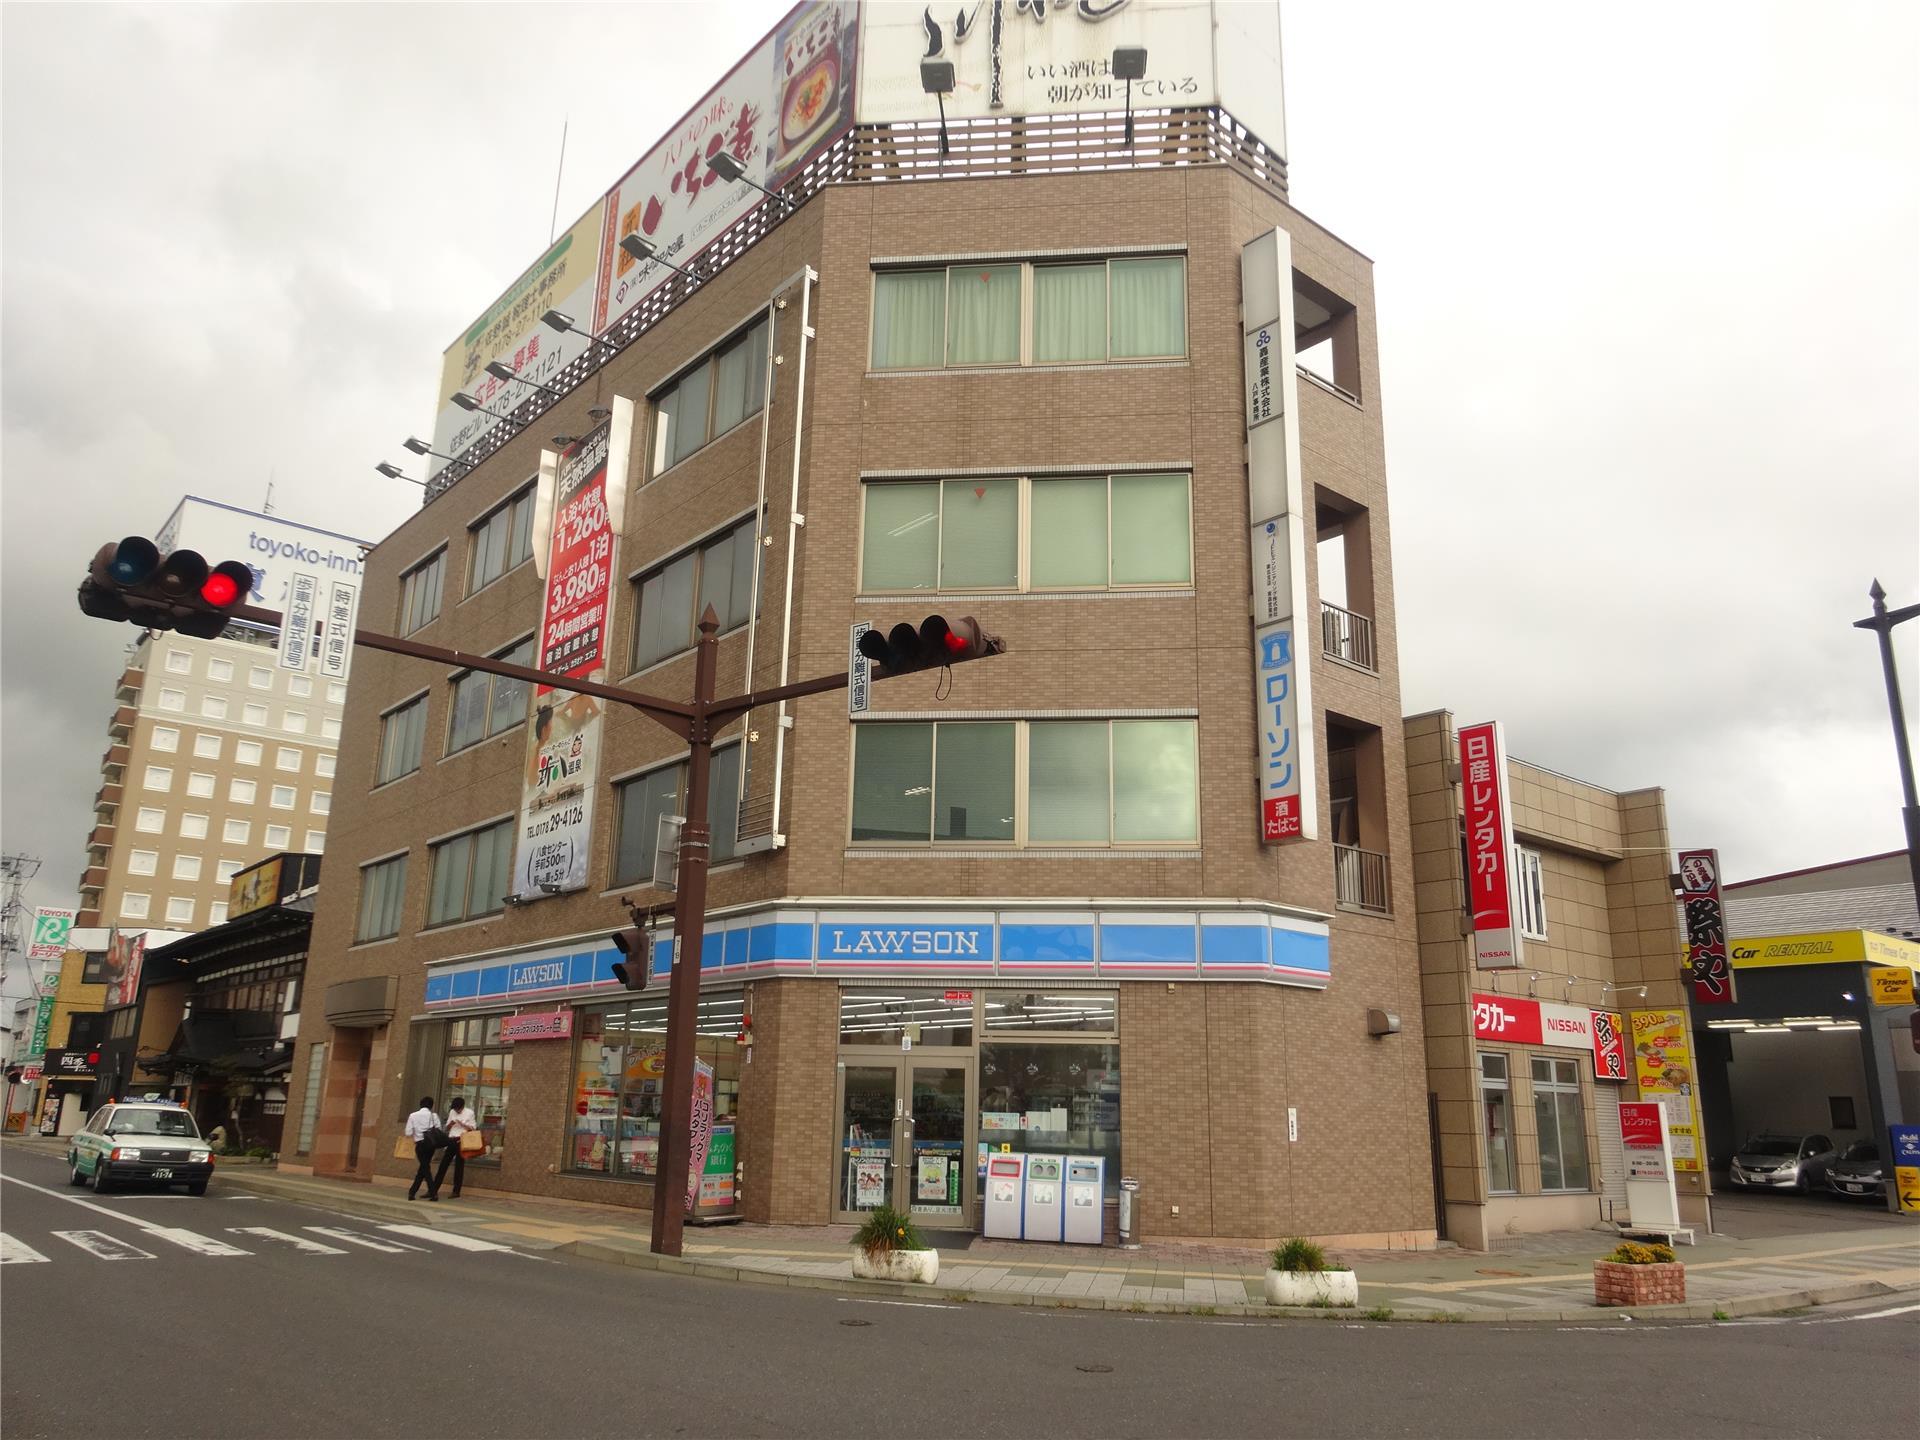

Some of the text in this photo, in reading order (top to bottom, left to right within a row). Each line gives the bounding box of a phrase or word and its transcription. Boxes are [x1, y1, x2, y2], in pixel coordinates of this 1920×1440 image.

[1027, 59, 1112, 80] いい酒は
[1047, 76, 1199, 103] 朝が知っている
[485, 345, 562, 424] 0178-27-1121
[1265, 673, 1292, 789] ローソン
[1275, 800, 1289, 817] 酒
[1467, 735, 1497, 891] 日産レンタカー
[1266, 815, 1299, 835] たばこ
[38, 908, 73, 918] TOYOTA
[832, 930, 979, 954] LAWSON
[1732, 940, 1834, 961] Car RENTAL
[1479, 950, 1511, 958] NISSAN
[513, 962, 564, 986] LAWSON
[1876, 978, 1908, 986] Times
[1884, 985, 1902, 993] Car
[1473, 1003, 1516, 1031] タカー
[1547, 1017, 1586, 1034] NISSAN
[1622, 1108, 1638, 1117] 日産
[1624, 1118, 1657, 1126] レンタカー
